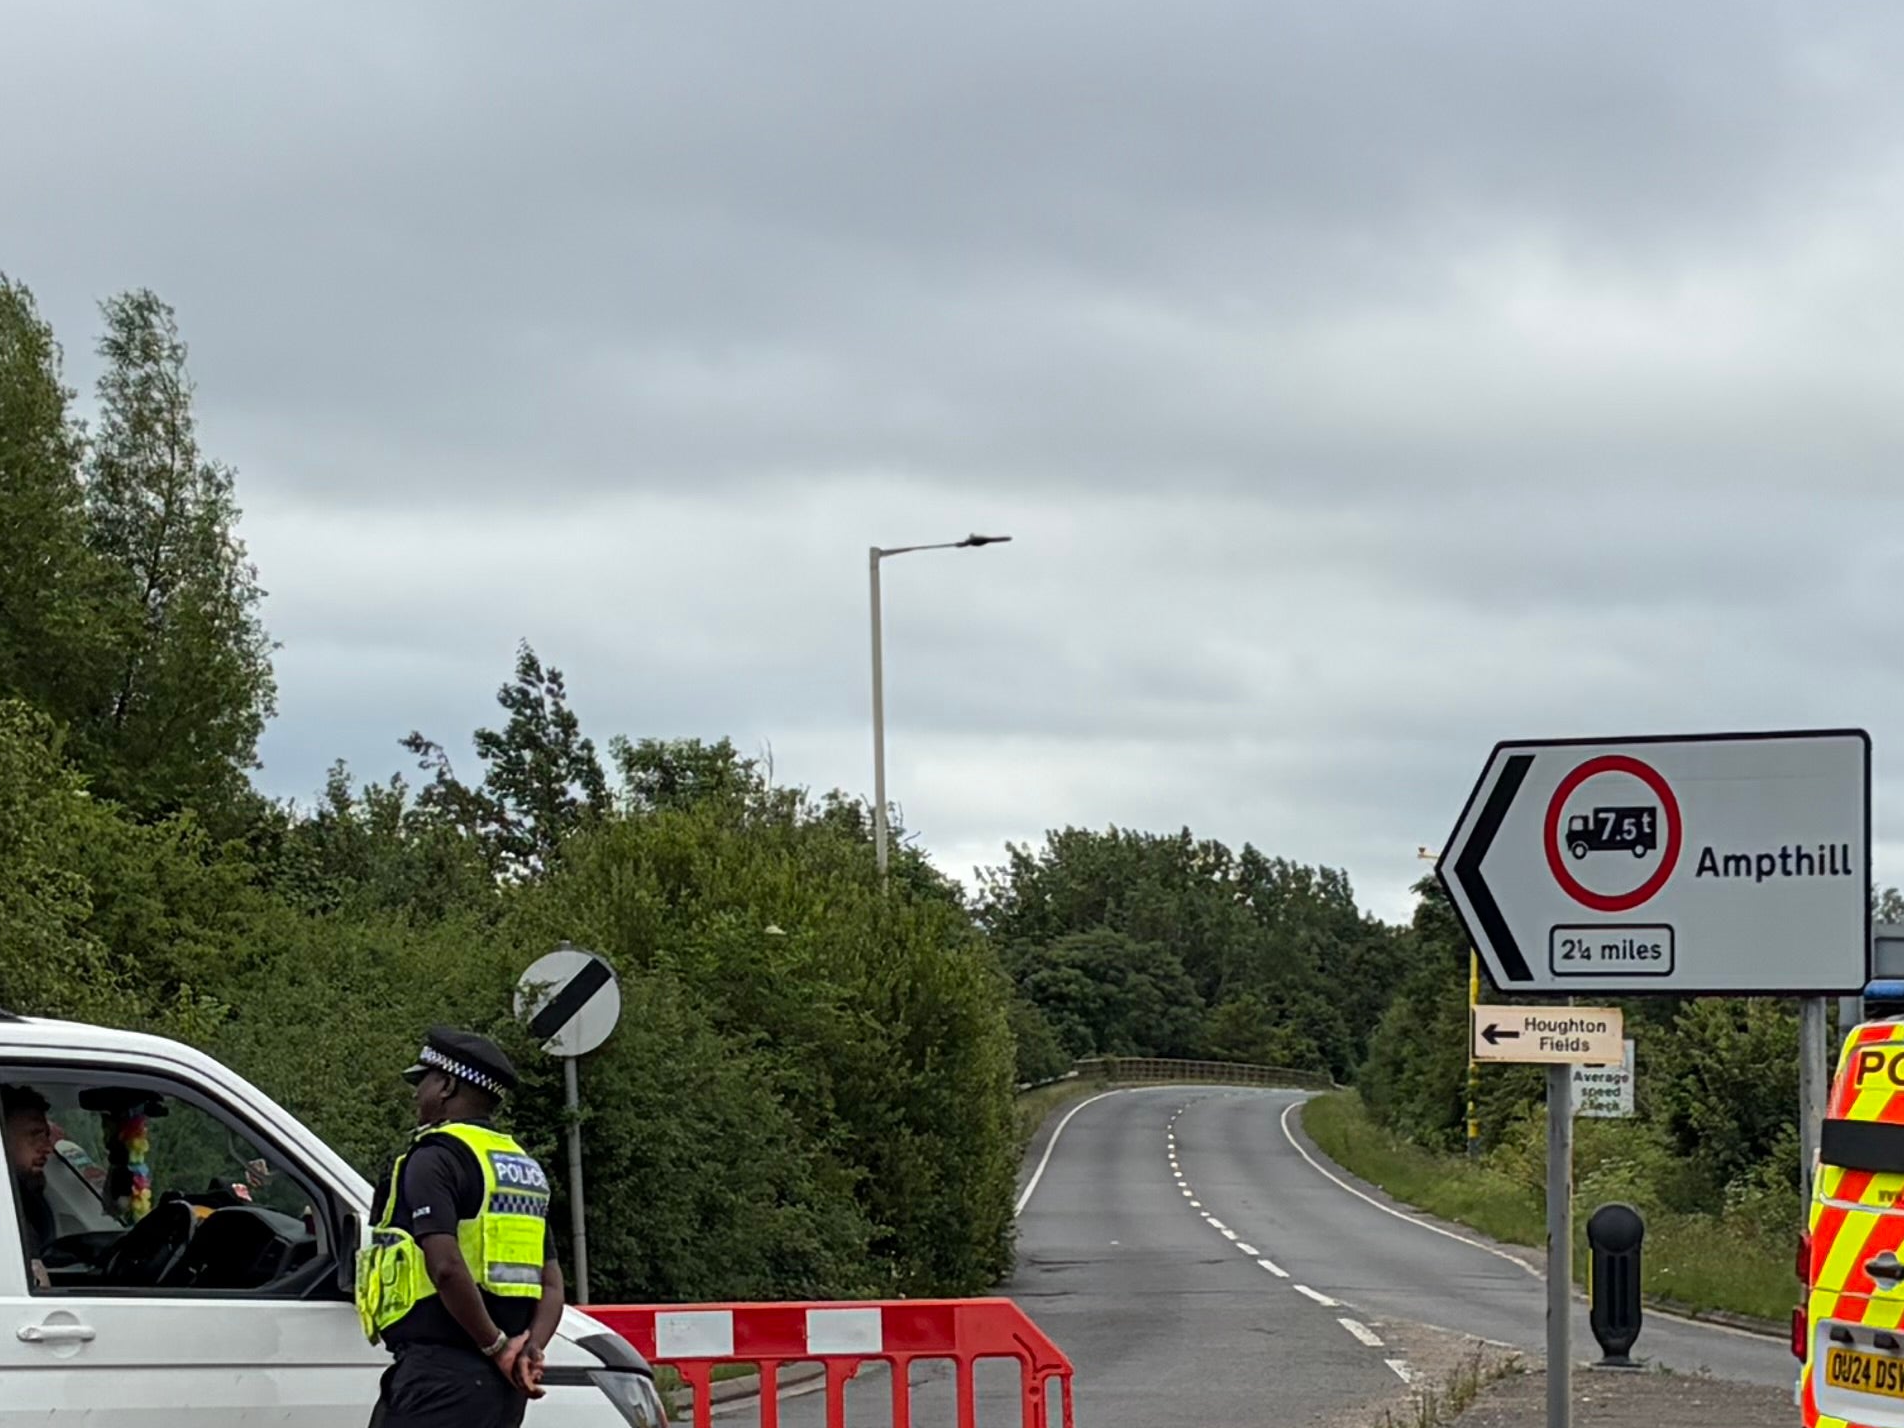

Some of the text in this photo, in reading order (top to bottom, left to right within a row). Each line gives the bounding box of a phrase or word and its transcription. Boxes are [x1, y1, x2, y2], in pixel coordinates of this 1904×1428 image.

[1696, 843, 1853, 883] Ampthill
[1600, 939, 1662, 960] miles
[1524, 1017, 1607, 1035] Houghton
[1539, 1037, 1591, 1052] Fields
[1572, 1071, 1630, 1085] Average
[1581, 1087, 1621, 1100] speed
[1832, 1353, 1872, 1387] OU24
